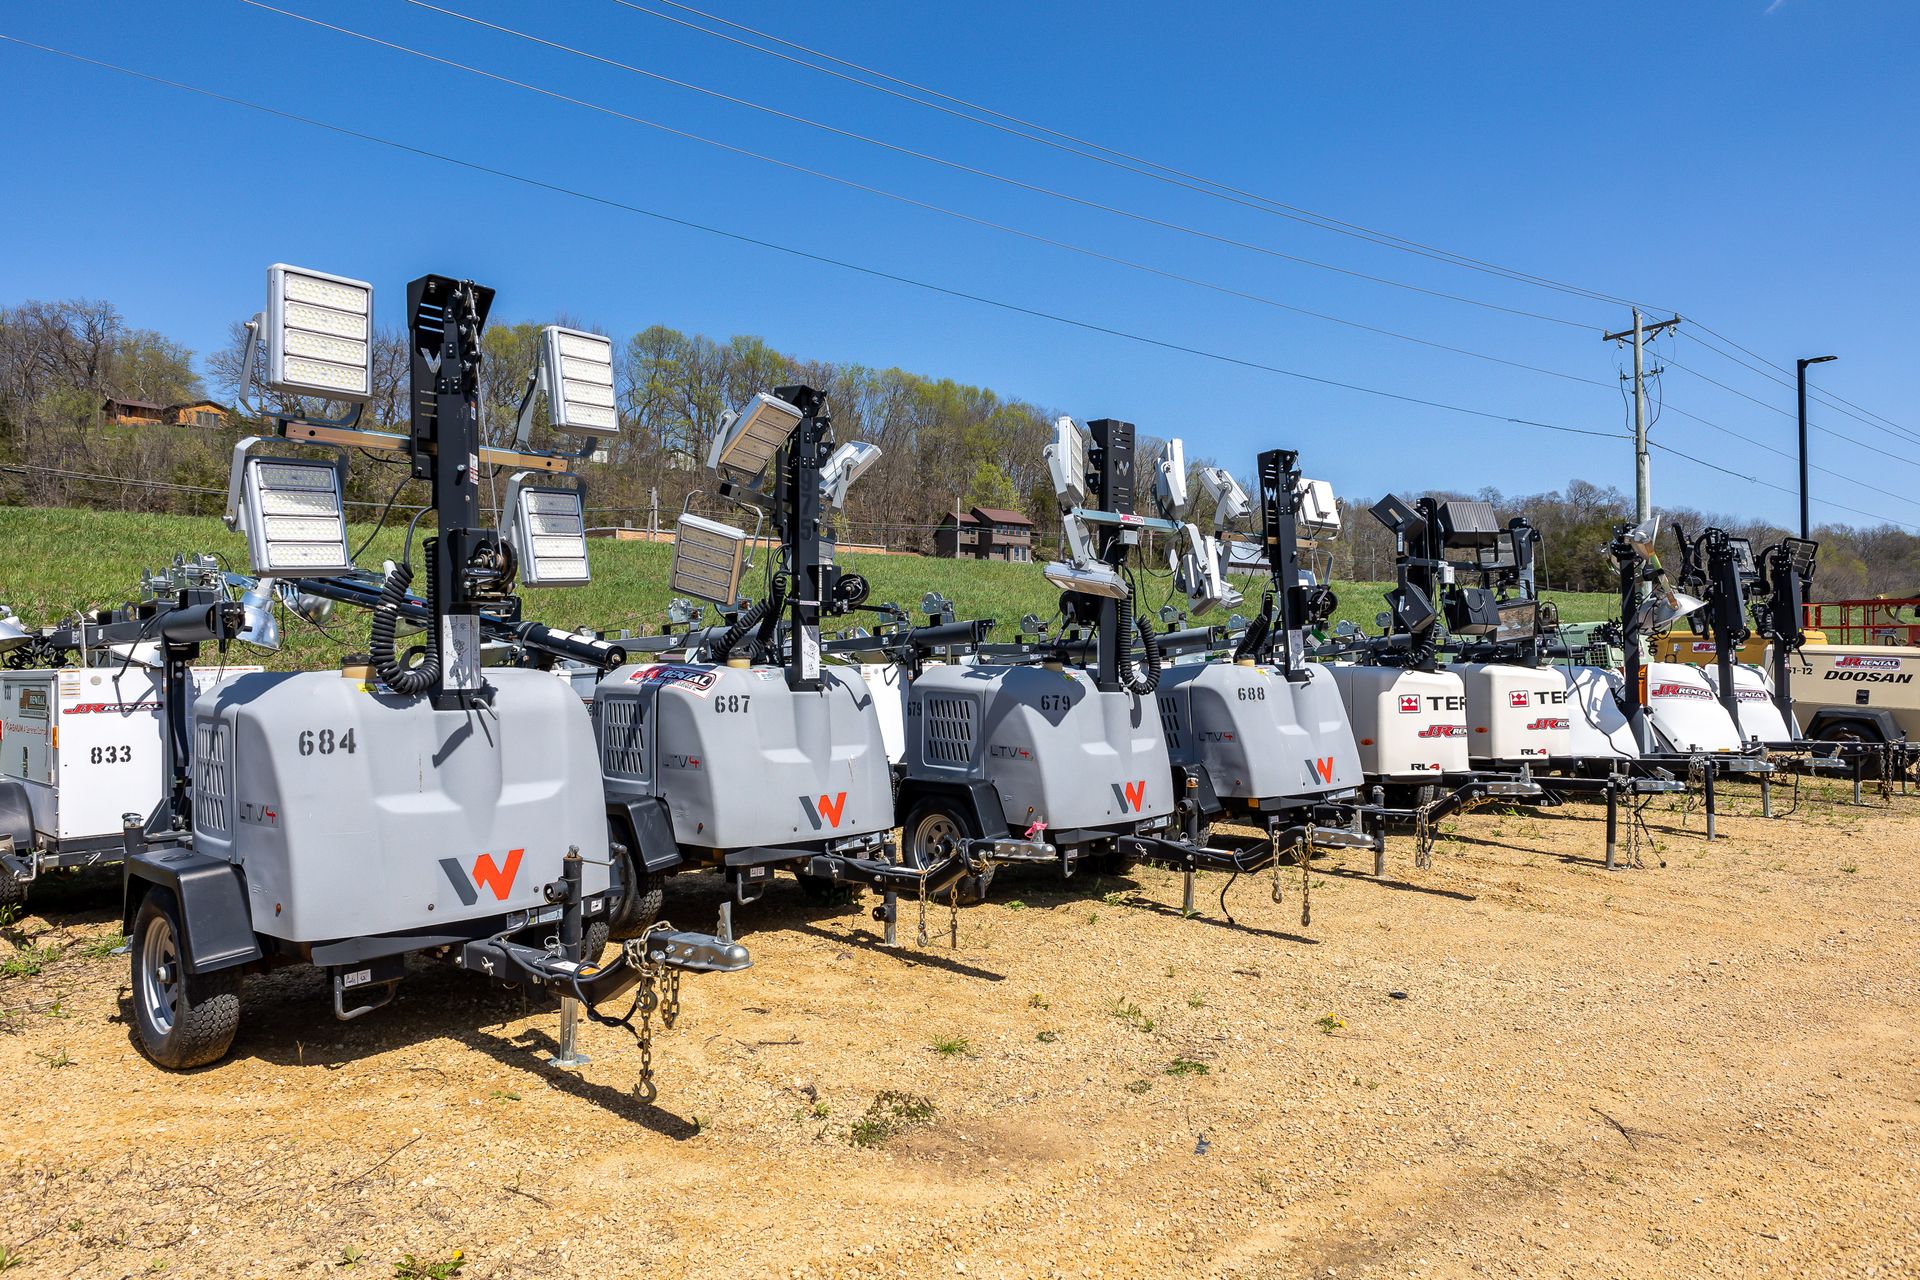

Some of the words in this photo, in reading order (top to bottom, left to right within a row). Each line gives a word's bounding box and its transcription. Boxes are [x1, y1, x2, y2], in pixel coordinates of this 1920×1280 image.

[1859, 659, 1898, 667] RENTAL
[659, 670, 711, 686] RENTAL
[1824, 670, 1913, 684] DOOSAN
[1238, 687, 1265, 700] 688
[1678, 687, 1711, 697] RENTAL
[101, 702, 163, 712] RENTAL
[715, 695, 750, 713] 687
[907, 702, 922, 716] 679
[1041, 695, 1071, 711] 679
[298, 728, 356, 756] 684
[1198, 732, 1233, 742] LTV4
[91, 746, 131, 764] 833
[989, 746, 1029, 759] LTV4
[1520, 748, 1547, 756] RL4
[1410, 763, 1440, 771] RL4
[239, 801, 276, 824] LTV4
